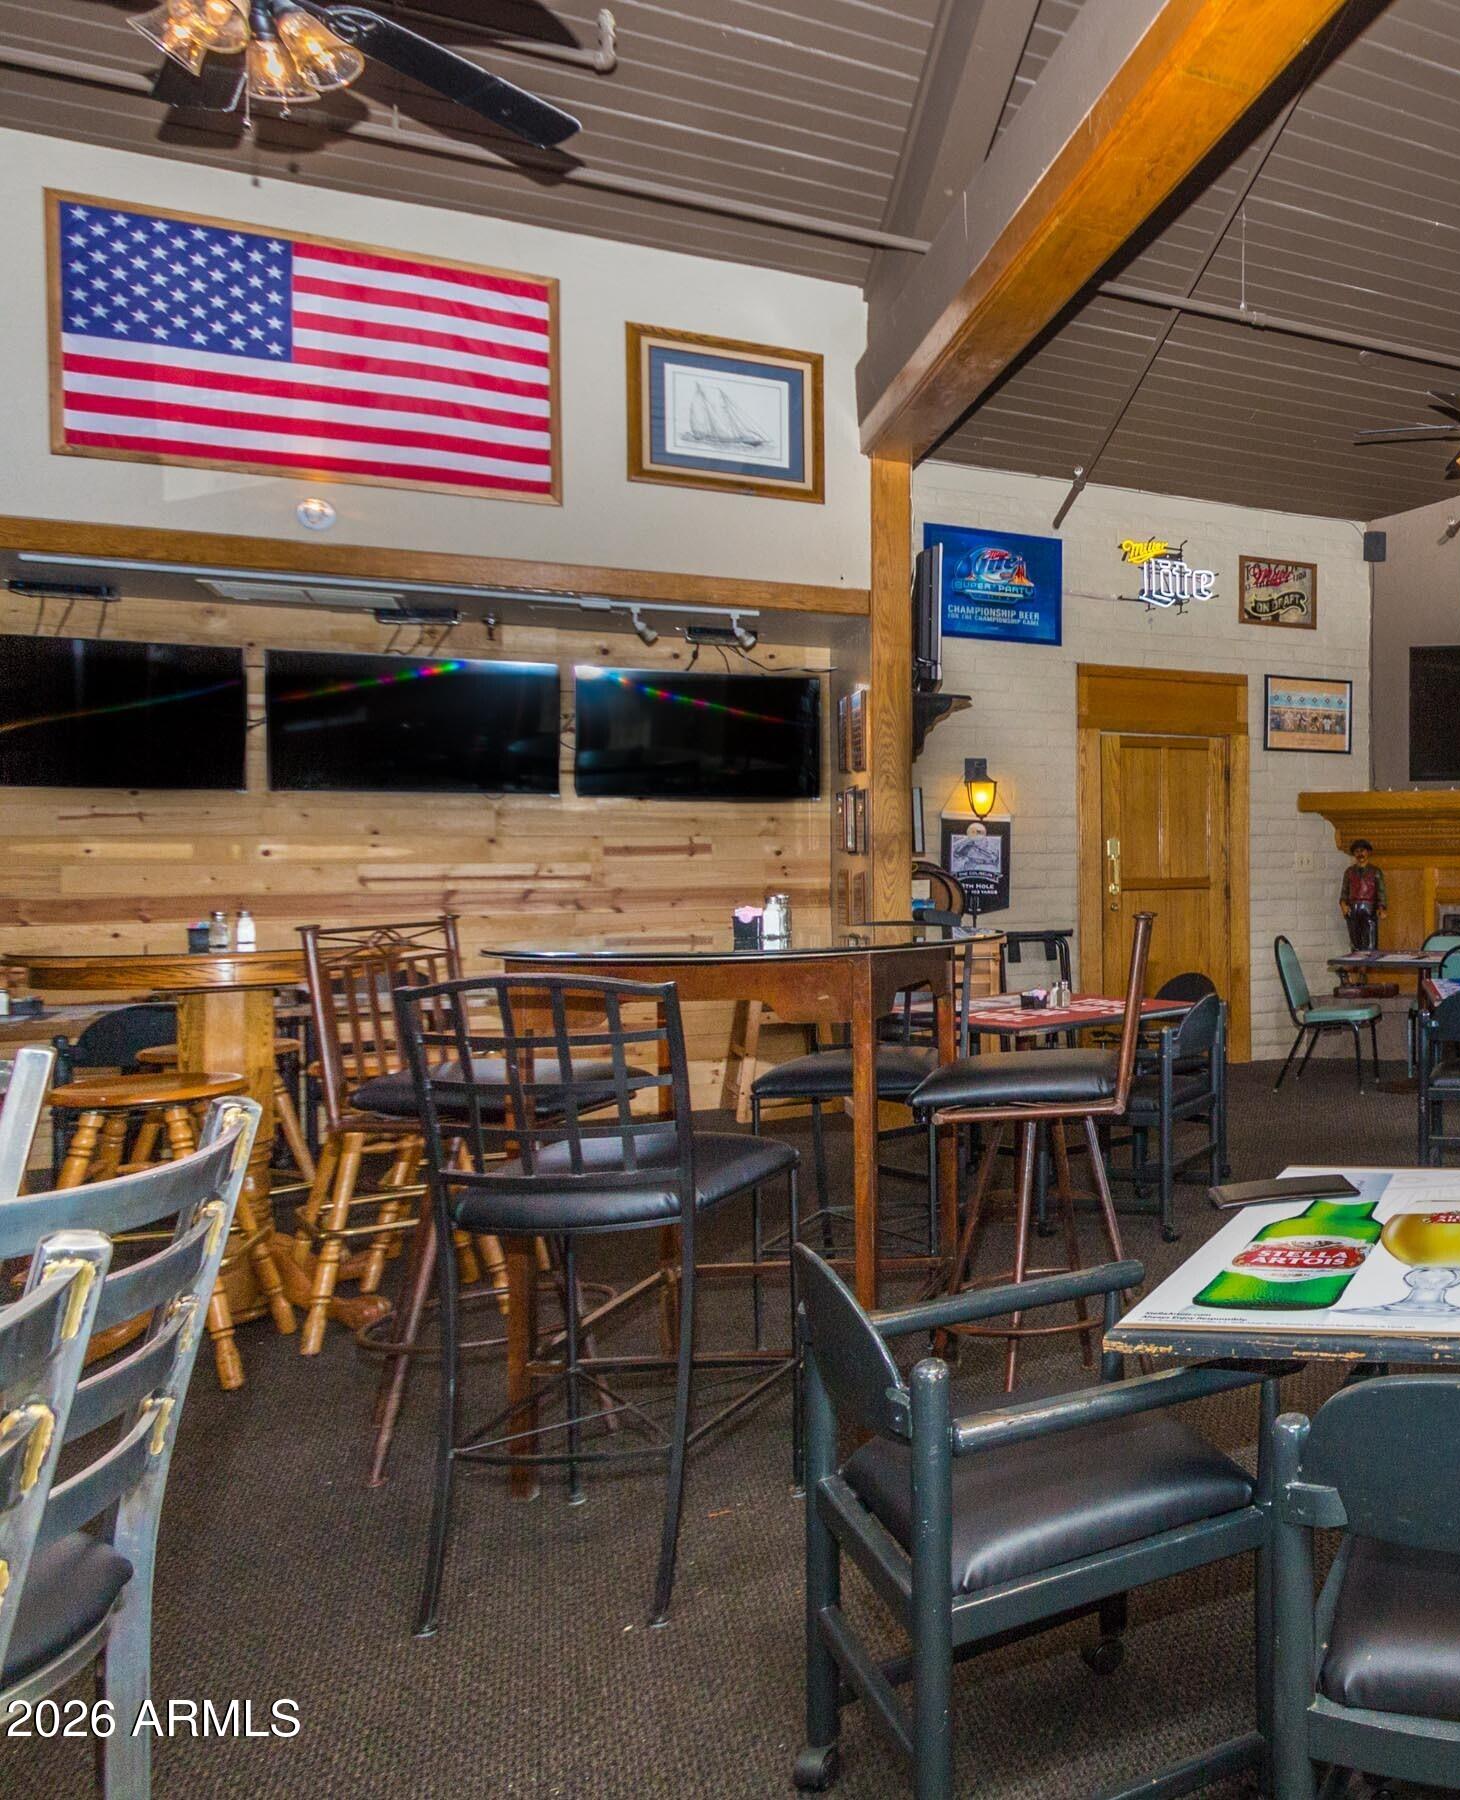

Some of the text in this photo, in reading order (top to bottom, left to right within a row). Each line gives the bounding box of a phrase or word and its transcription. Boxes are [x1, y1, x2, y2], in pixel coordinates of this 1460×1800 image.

[1122, 540, 1168, 564] Miller
[1139, 558, 1215, 608] Lite
[1256, 594, 1300, 613] ON DRAFT
[948, 604, 1040, 621] CHAMPIONSHIP BEER
[974, 614, 1021, 625] CHAMPIONSHIP
[1250, 1257, 1346, 1265] ARTOIS
[1258, 1250, 1348, 1258] STELLA
